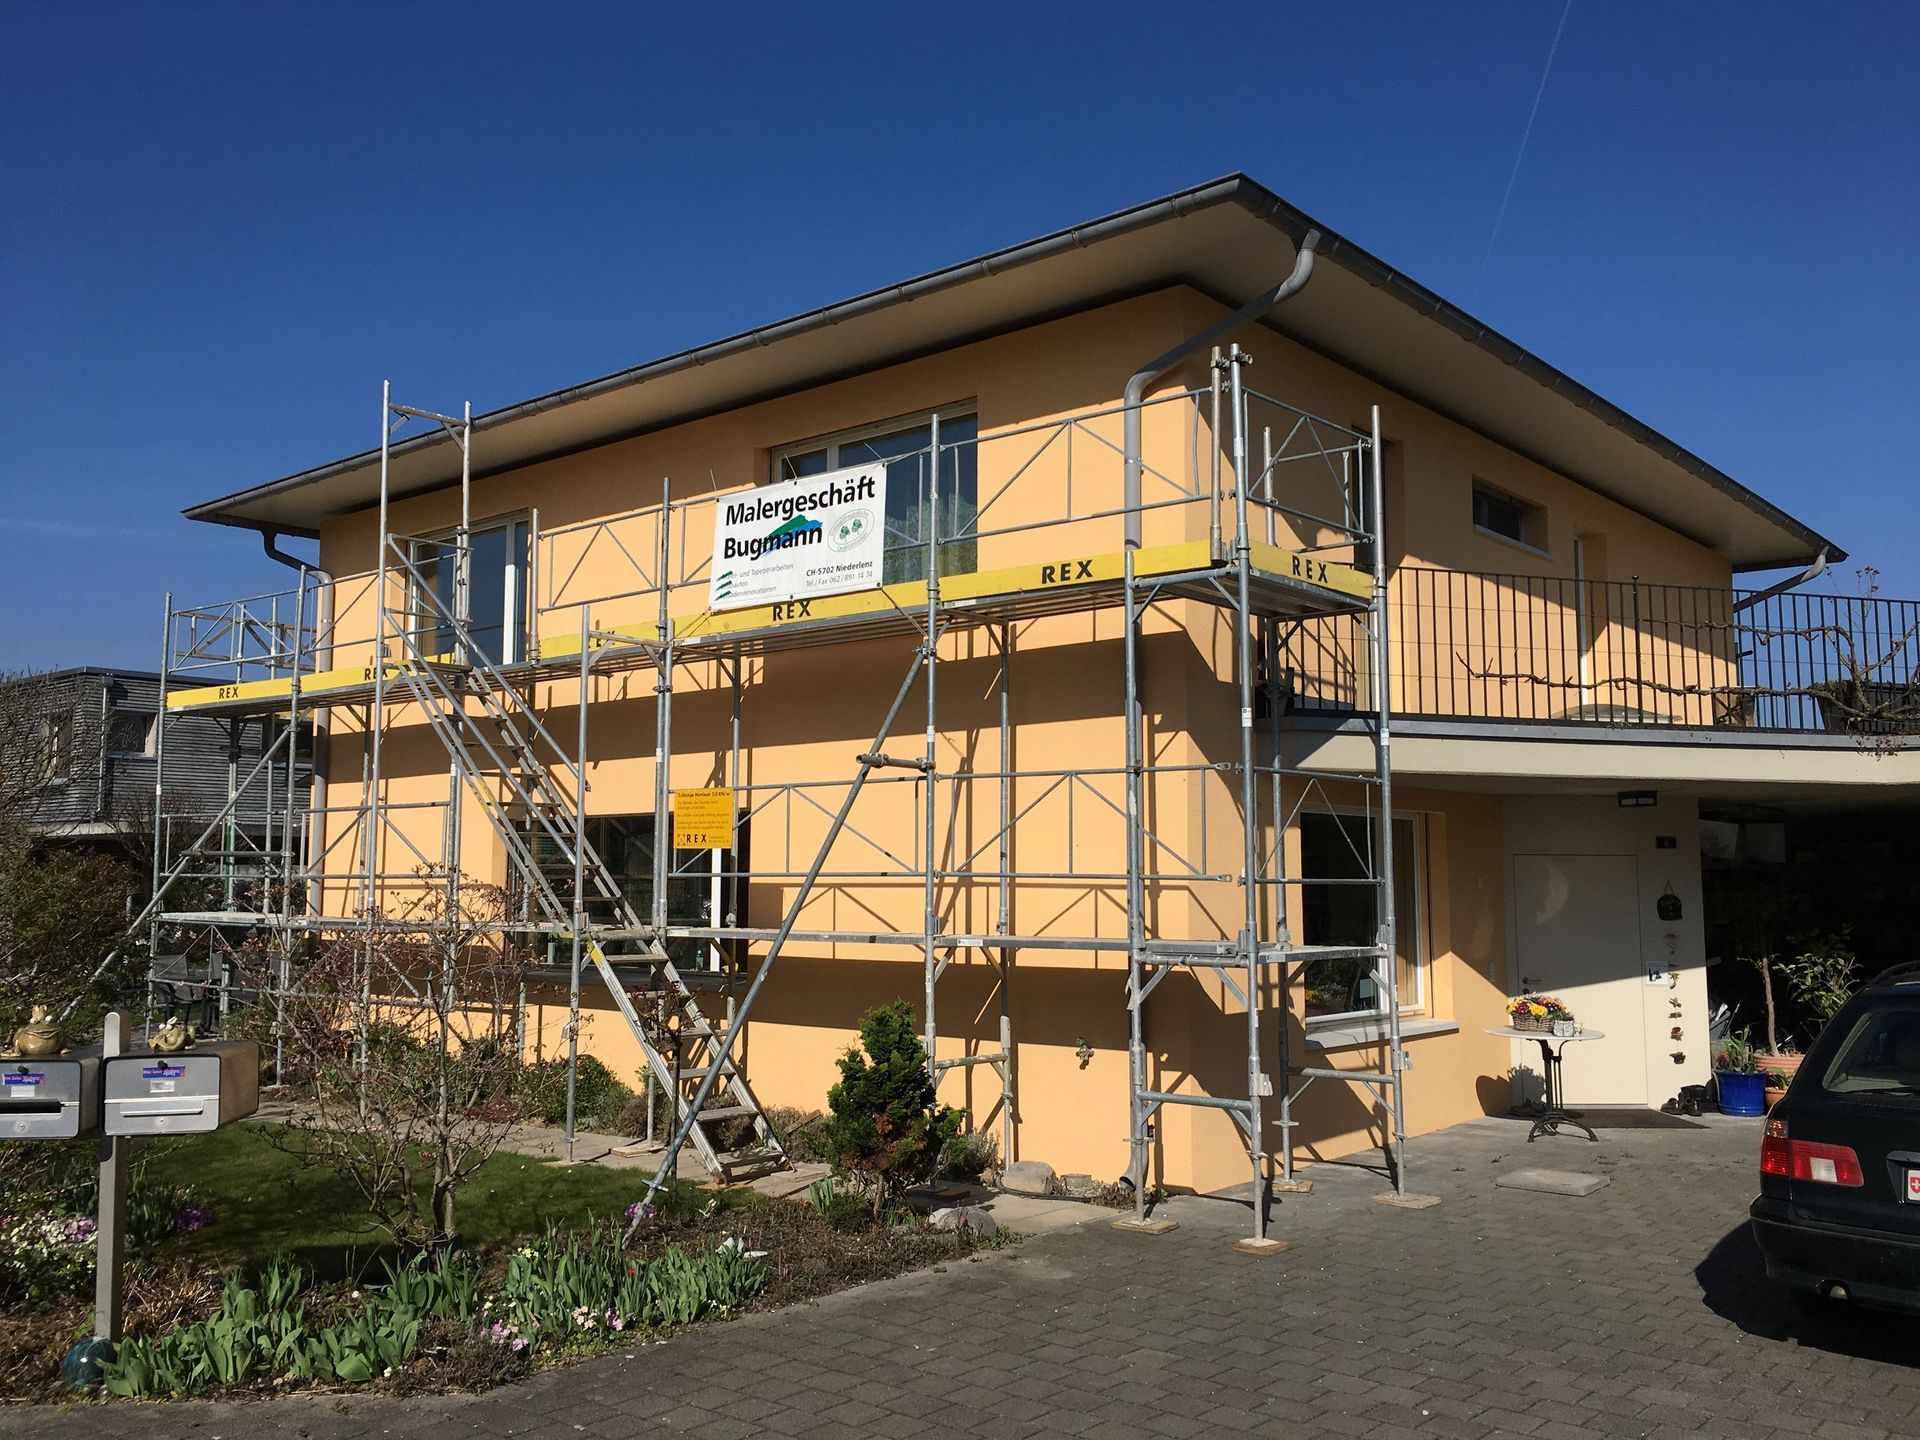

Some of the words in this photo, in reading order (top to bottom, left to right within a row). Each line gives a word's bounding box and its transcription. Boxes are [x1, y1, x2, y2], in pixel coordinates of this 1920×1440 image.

[725, 475, 875, 526] Malergeschäft
[723, 526, 823, 561] Bugmann
[806, 566, 834, 577] CH-5702
[836, 561, 873, 572] Niederlenz
[1041, 559, 1094, 584] REX
[1292, 554, 1329, 584] REX
[772, 600, 811, 621] REX
[219, 686, 239, 699] REX
[686, 833, 707, 843] REX
